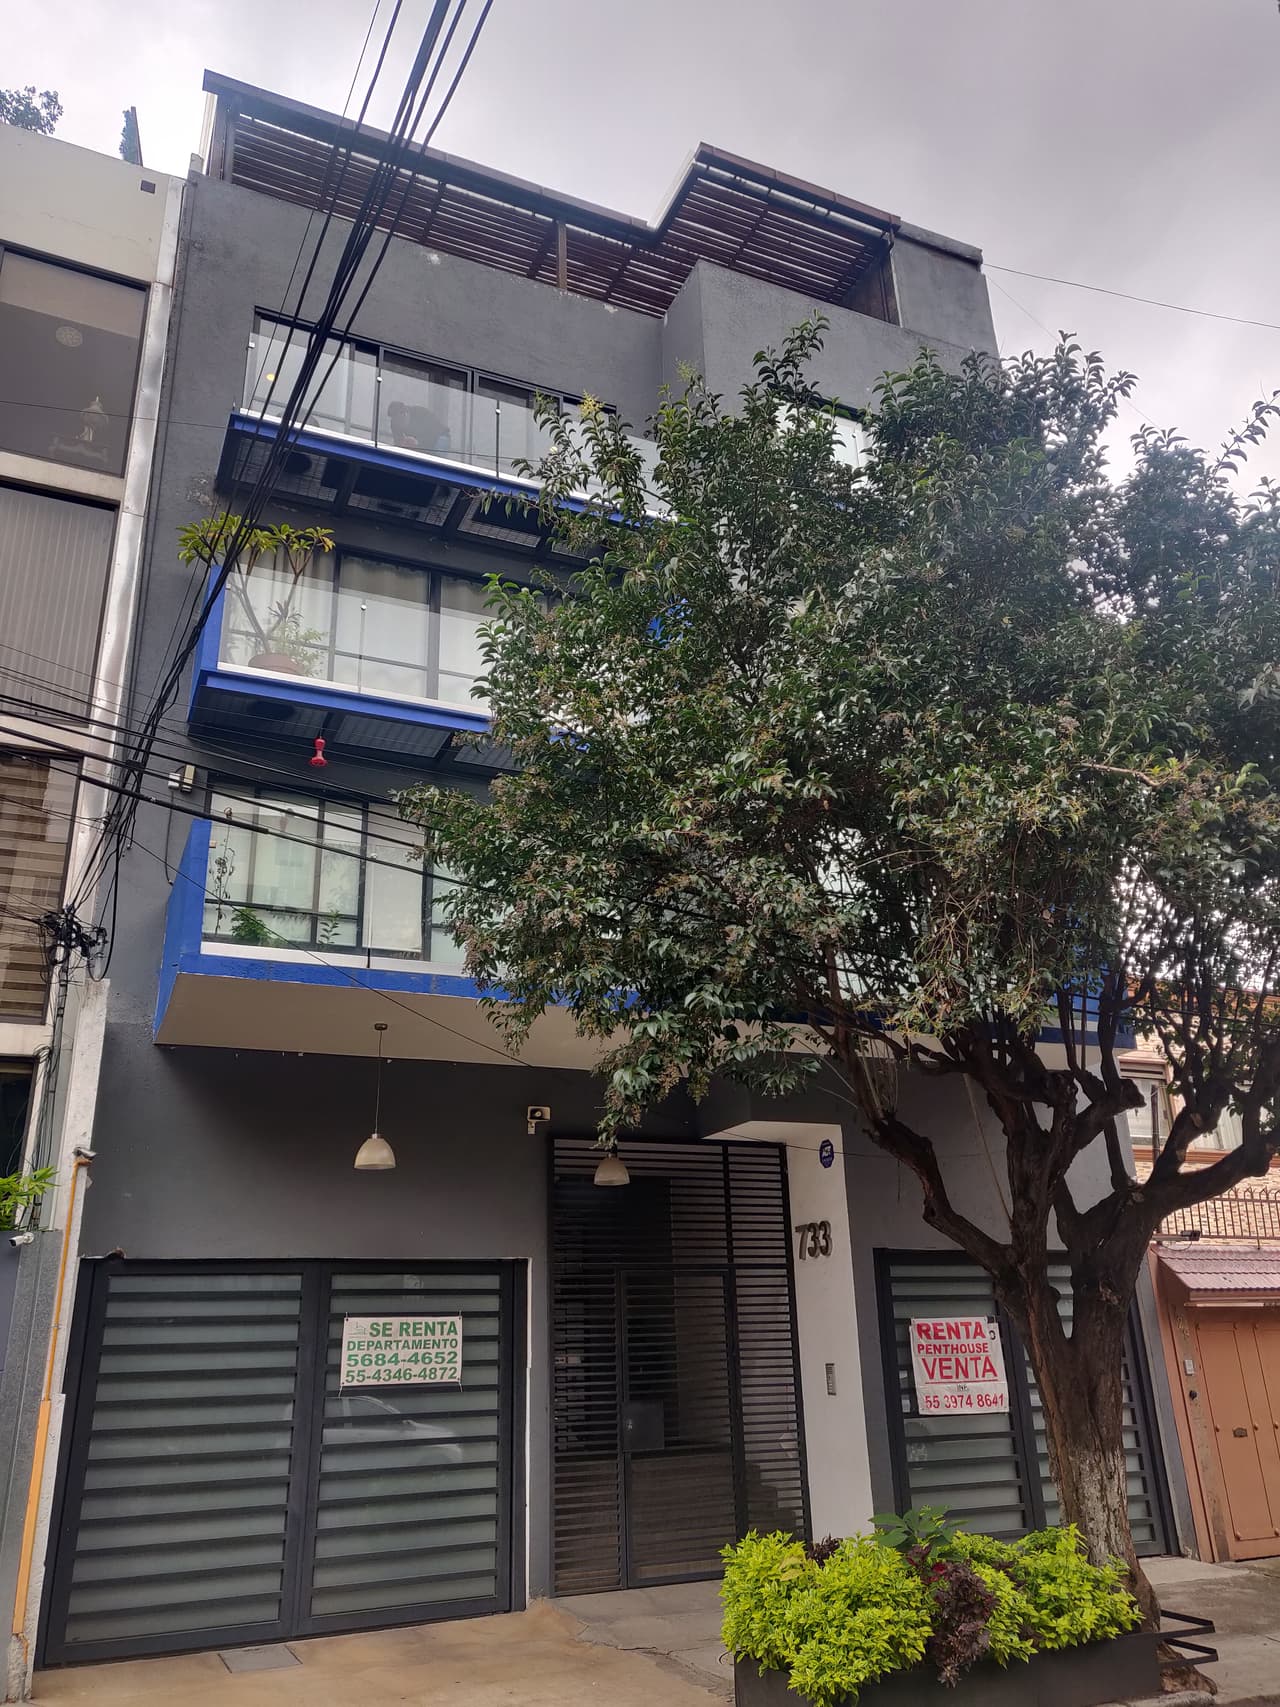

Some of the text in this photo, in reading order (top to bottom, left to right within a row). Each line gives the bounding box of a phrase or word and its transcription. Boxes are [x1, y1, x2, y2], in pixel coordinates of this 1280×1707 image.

[795, 1220, 833, 1261] 733
[369, 1321, 458, 1337] SE RENTA
[916, 1321, 986, 1340] RENTA
[347, 1338, 458, 1351] DEPARTAMENTO
[917, 1343, 988, 1354] PENTHOUSE
[346, 1351, 458, 1367] 5684-4652
[345, 1367, 457, 1383] 55-4346-4872
[921, 1356, 998, 1379] VENTA
[925, 1393, 1004, 1409] 55 3974 8641
